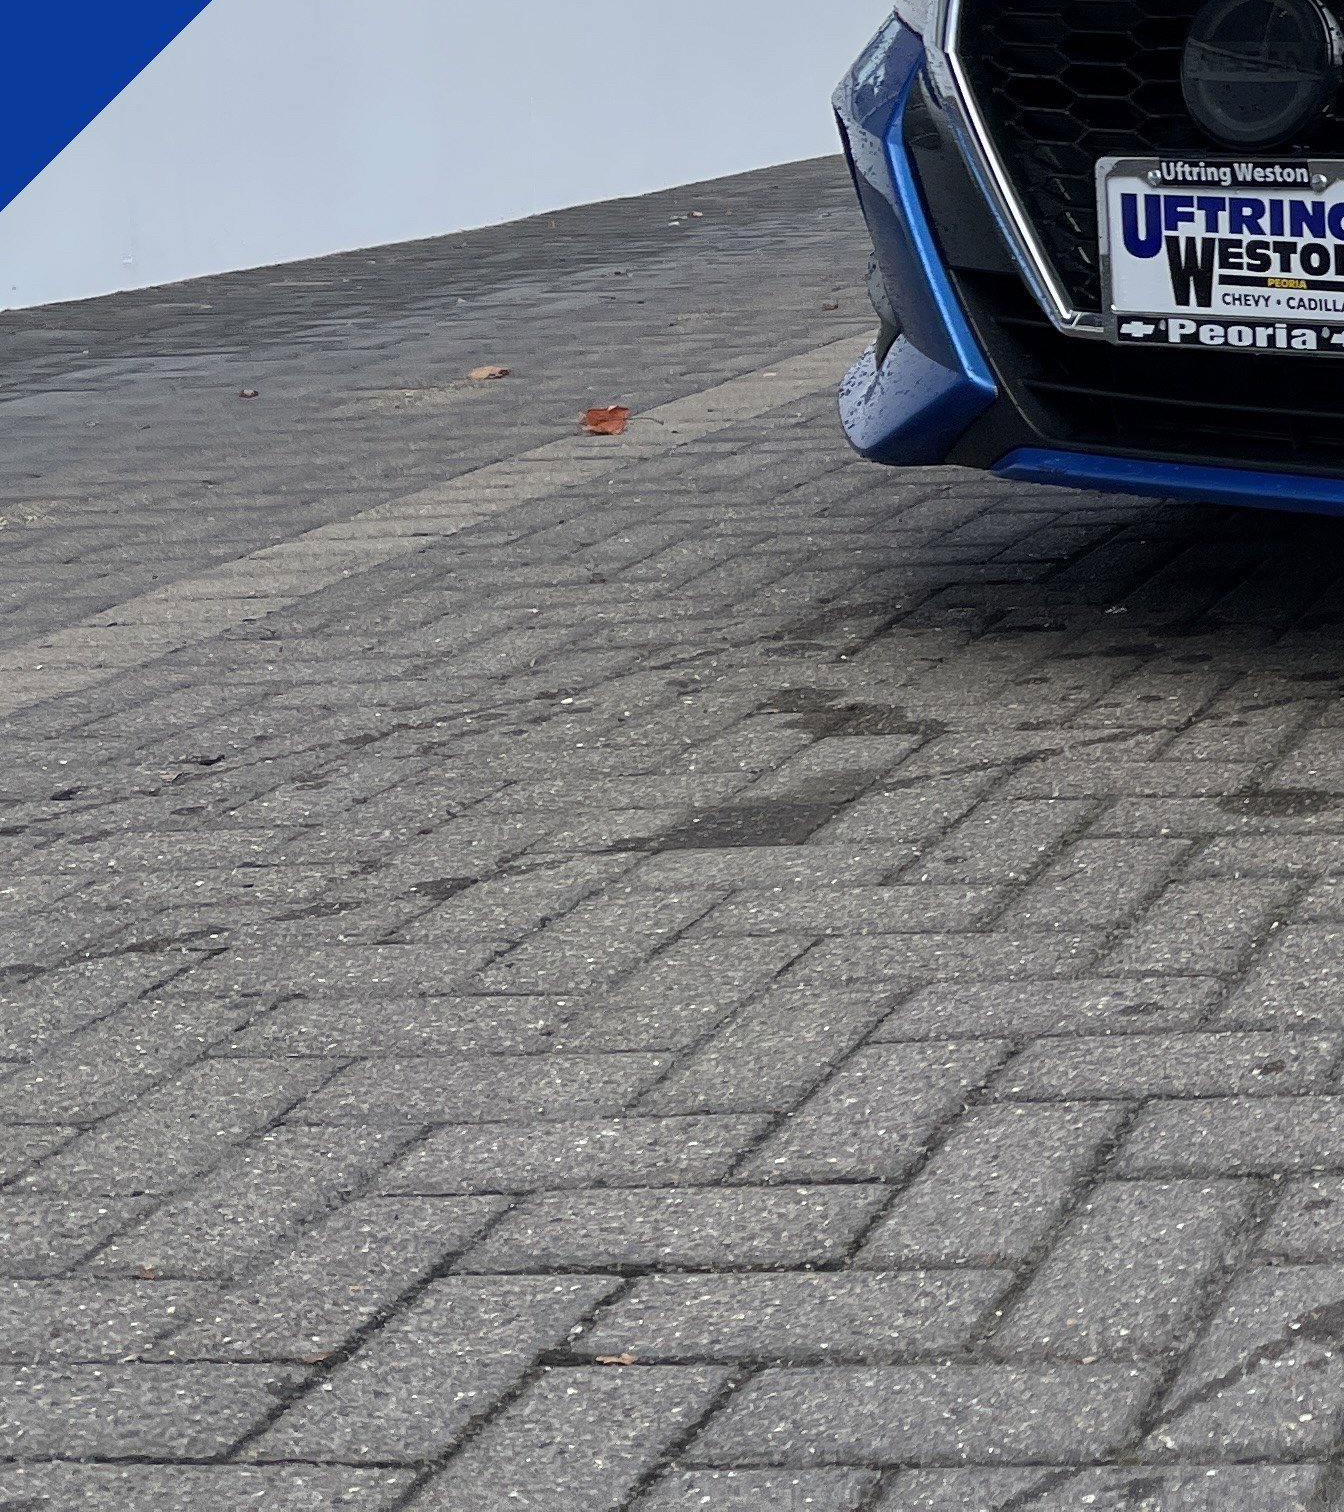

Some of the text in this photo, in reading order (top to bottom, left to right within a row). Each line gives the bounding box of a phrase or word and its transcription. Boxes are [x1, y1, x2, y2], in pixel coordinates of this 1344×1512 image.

[1161, 161, 1309, 186] Uftring Weston
[1267, 277, 1307, 289] PEORIA
[1222, 292, 1271, 307] CHEVY
[1167, 318, 1318, 350] Peoria
